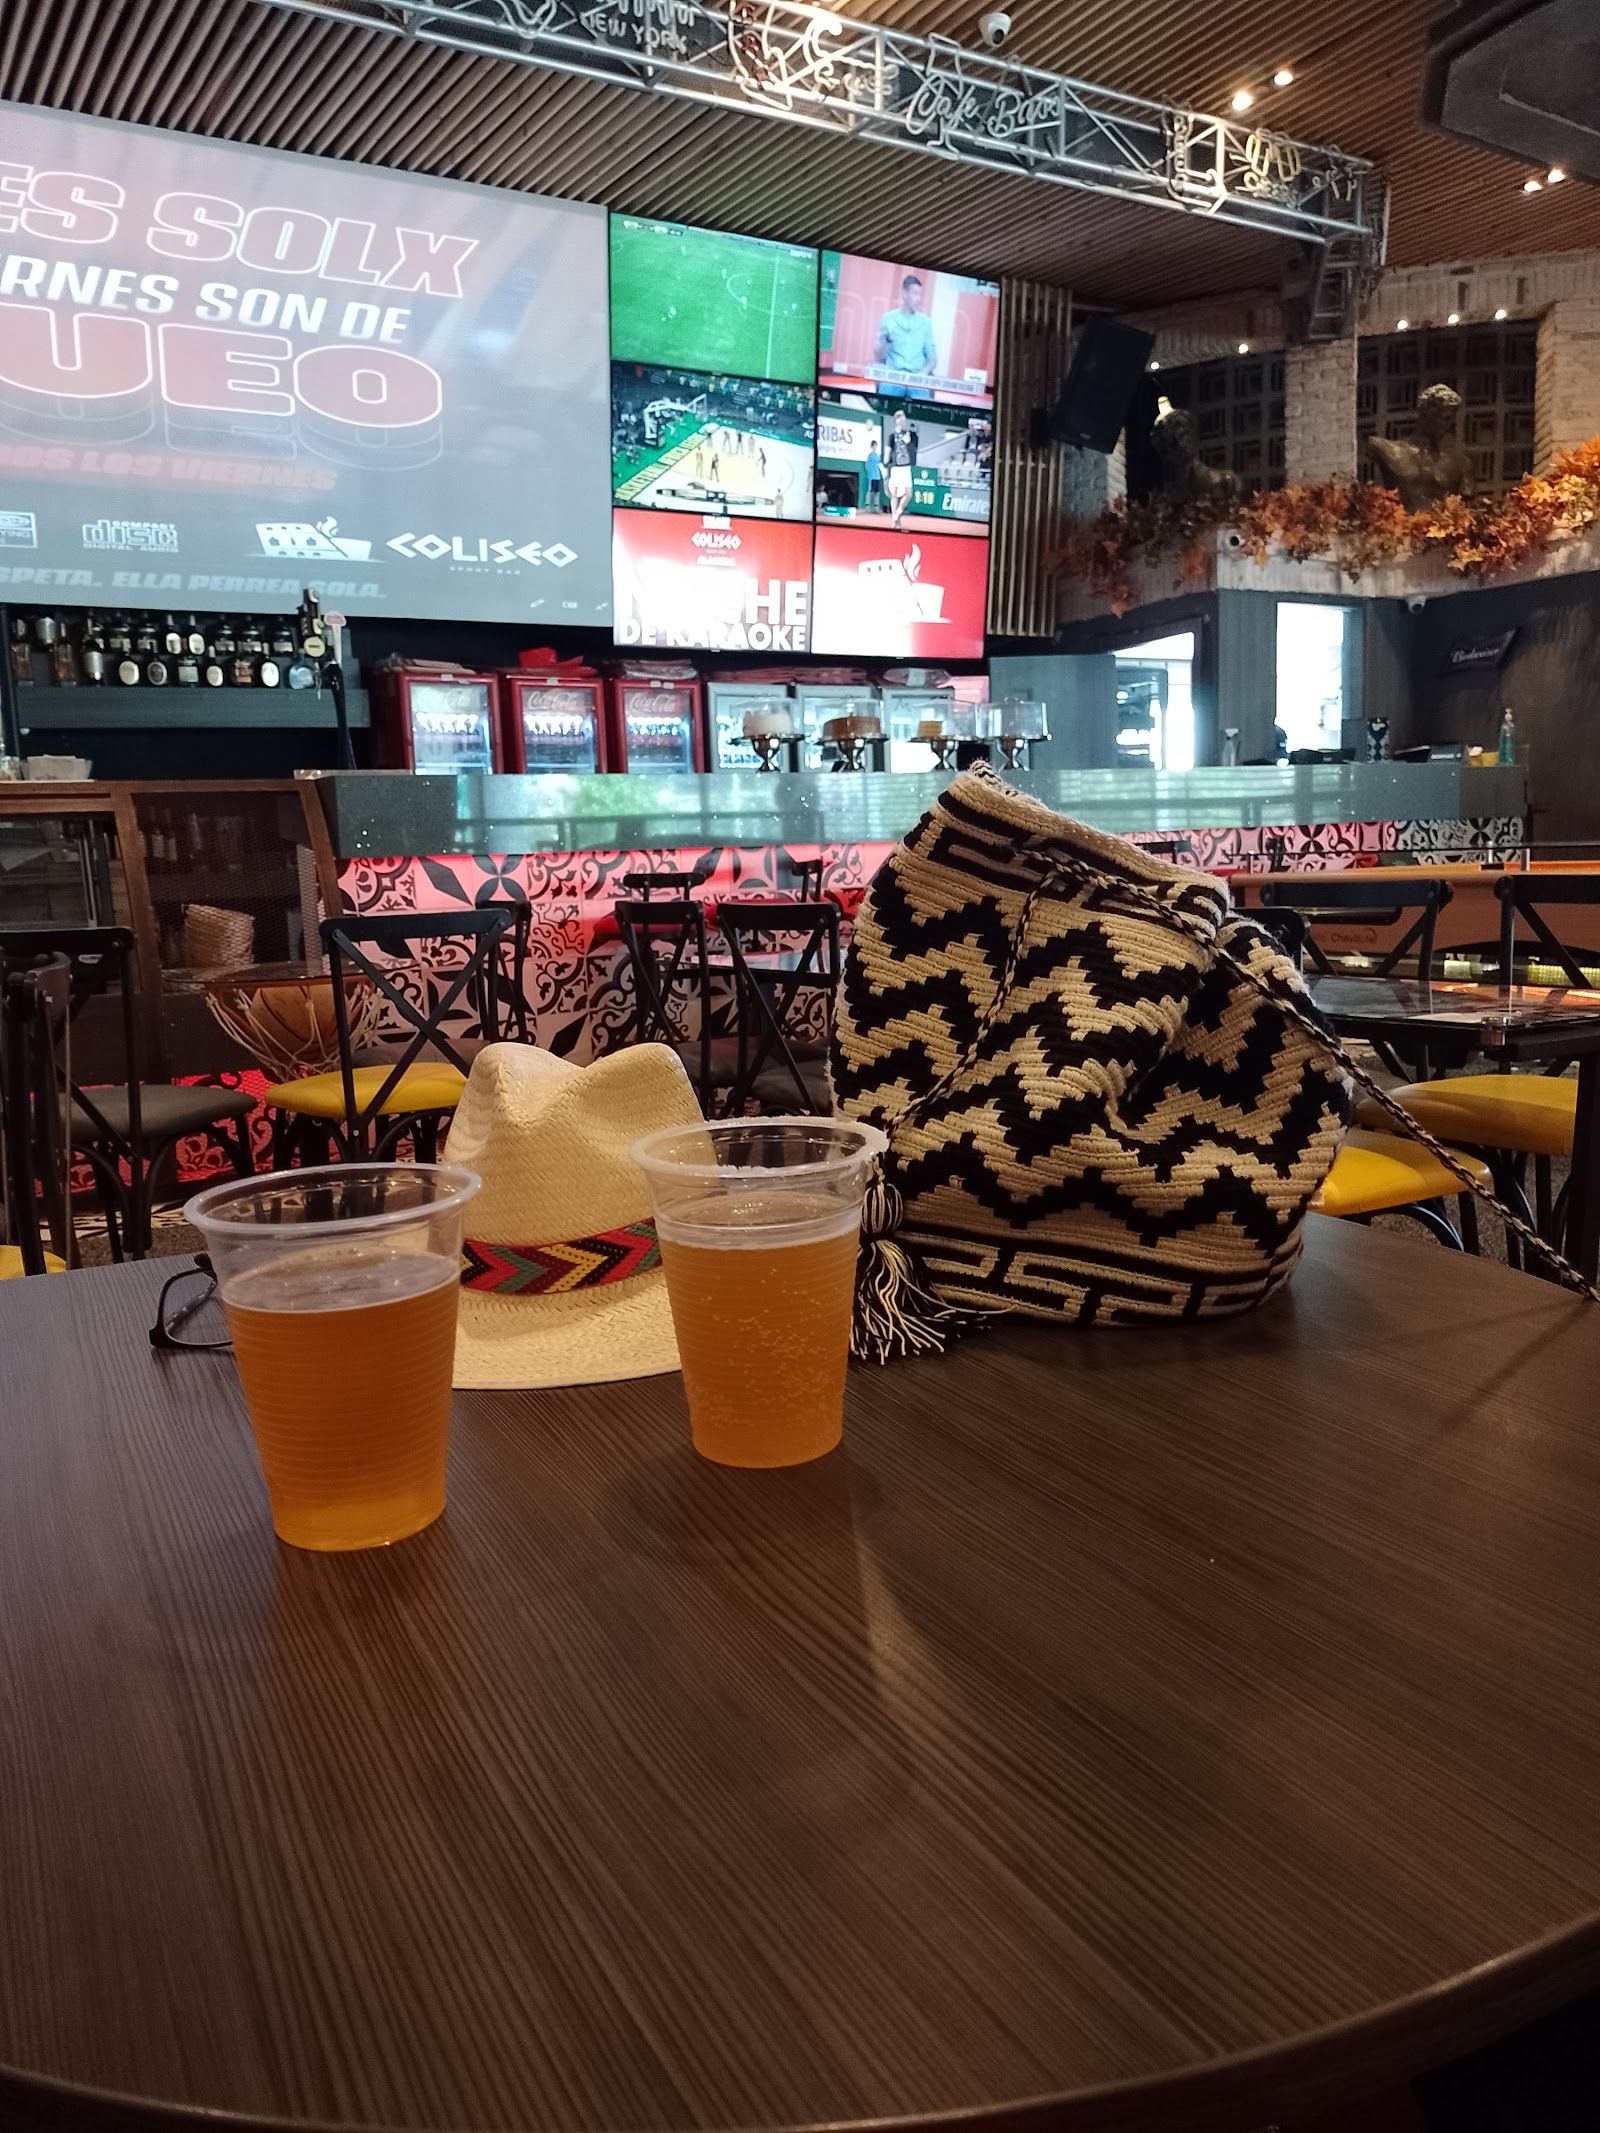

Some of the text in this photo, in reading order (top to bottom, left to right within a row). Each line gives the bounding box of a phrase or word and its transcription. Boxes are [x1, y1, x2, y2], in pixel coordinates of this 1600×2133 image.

[580, 12, 626, 37] NEW
[631, 23, 688, 55] YORK
[146, 191, 479, 298] SOLX
[195, 282, 328, 333] SON
[339, 301, 412, 344] DE
[79, 450, 163, 478] LOS
[386, 532, 578, 568] COLISEO
[112, 571, 182, 590] ELLA
[619, 618, 657, 645] DE
